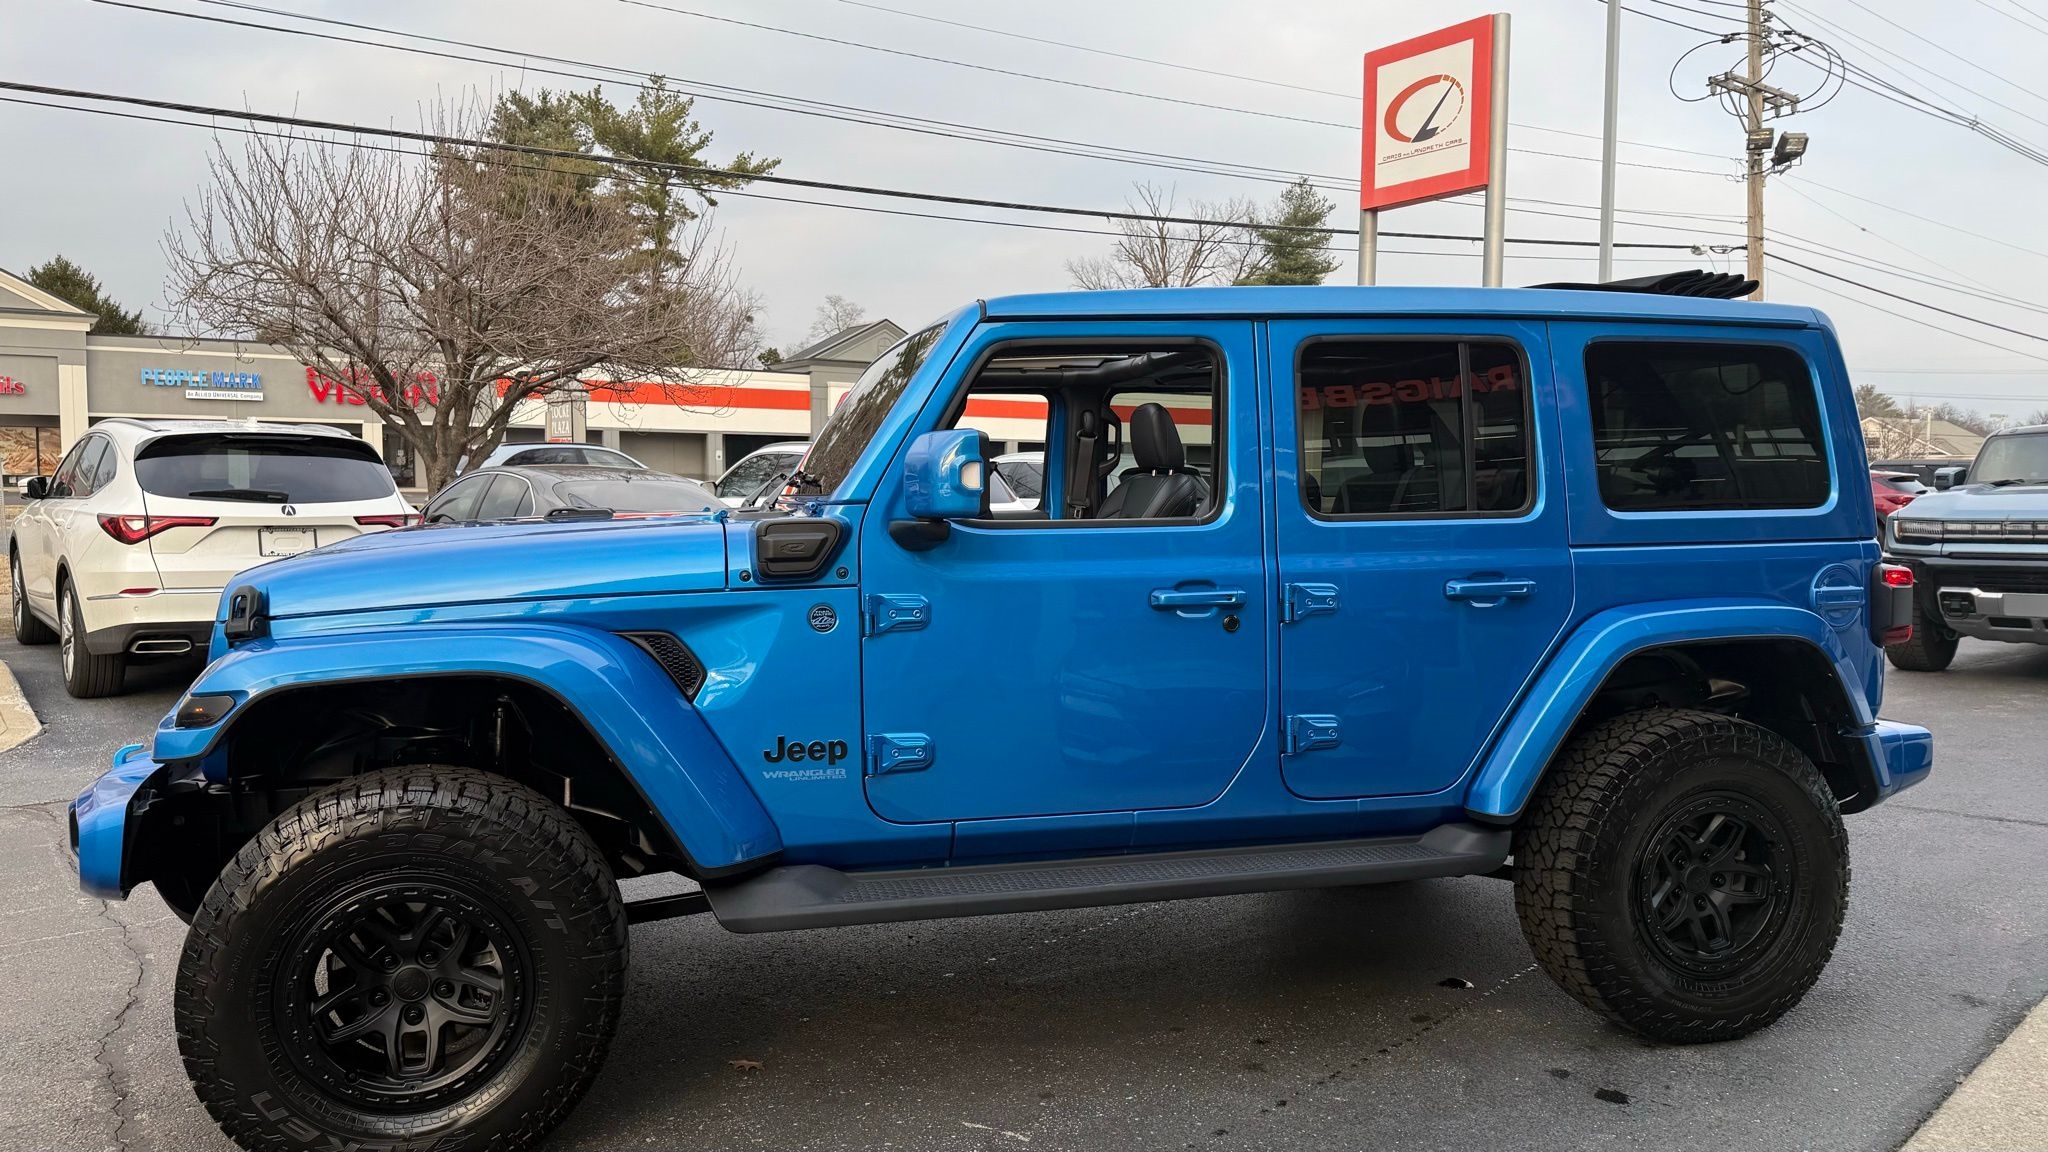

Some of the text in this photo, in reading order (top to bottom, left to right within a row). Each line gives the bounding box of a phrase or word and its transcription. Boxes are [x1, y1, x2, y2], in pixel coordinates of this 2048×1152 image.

[1382, 153, 1401, 161] CRAIG
[1410, 143, 1443, 154] LANDRETH
[1445, 138, 1462, 146] CARS
[141, 368, 261, 389] PEOPLE MARK
[551, 420, 570, 434] PLAZA
[763, 735, 848, 765] Jeep
[762, 768, 846, 779] WRANGLER
